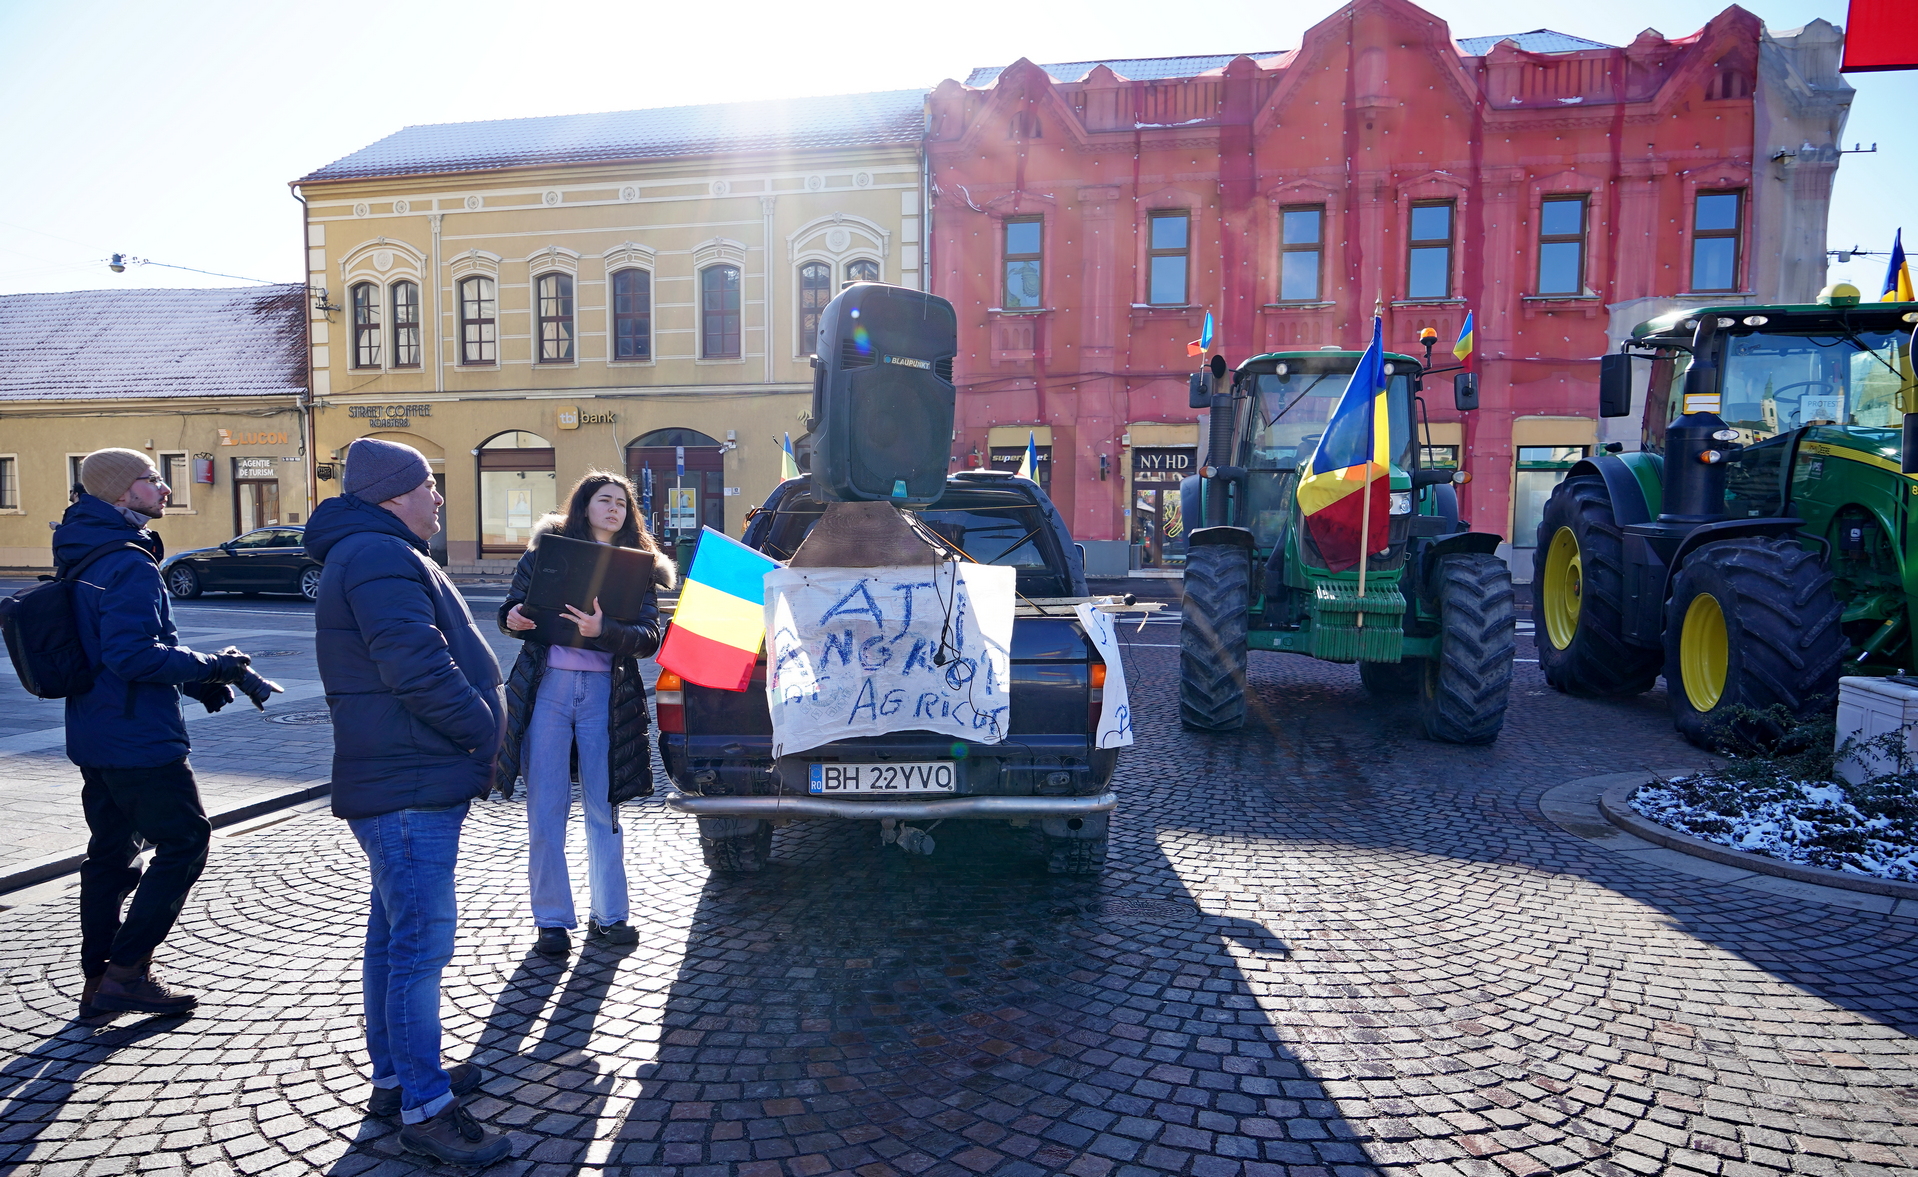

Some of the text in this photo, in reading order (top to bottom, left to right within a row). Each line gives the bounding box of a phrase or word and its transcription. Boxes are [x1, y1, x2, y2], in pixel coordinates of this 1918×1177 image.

[891, 357, 931, 370] BLAUPUNKT
[1807, 400, 1841, 408] PROTEST
[348, 404, 433, 418] STREET COFFEE
[559, 410, 616, 424] tbi bank
[240, 432, 288, 445] LUCON
[1140, 454, 1189, 469] NY HD
[240, 468, 274, 476] DE TURISM
[825, 766, 860, 790] BH
[811, 780, 822, 790] RO
